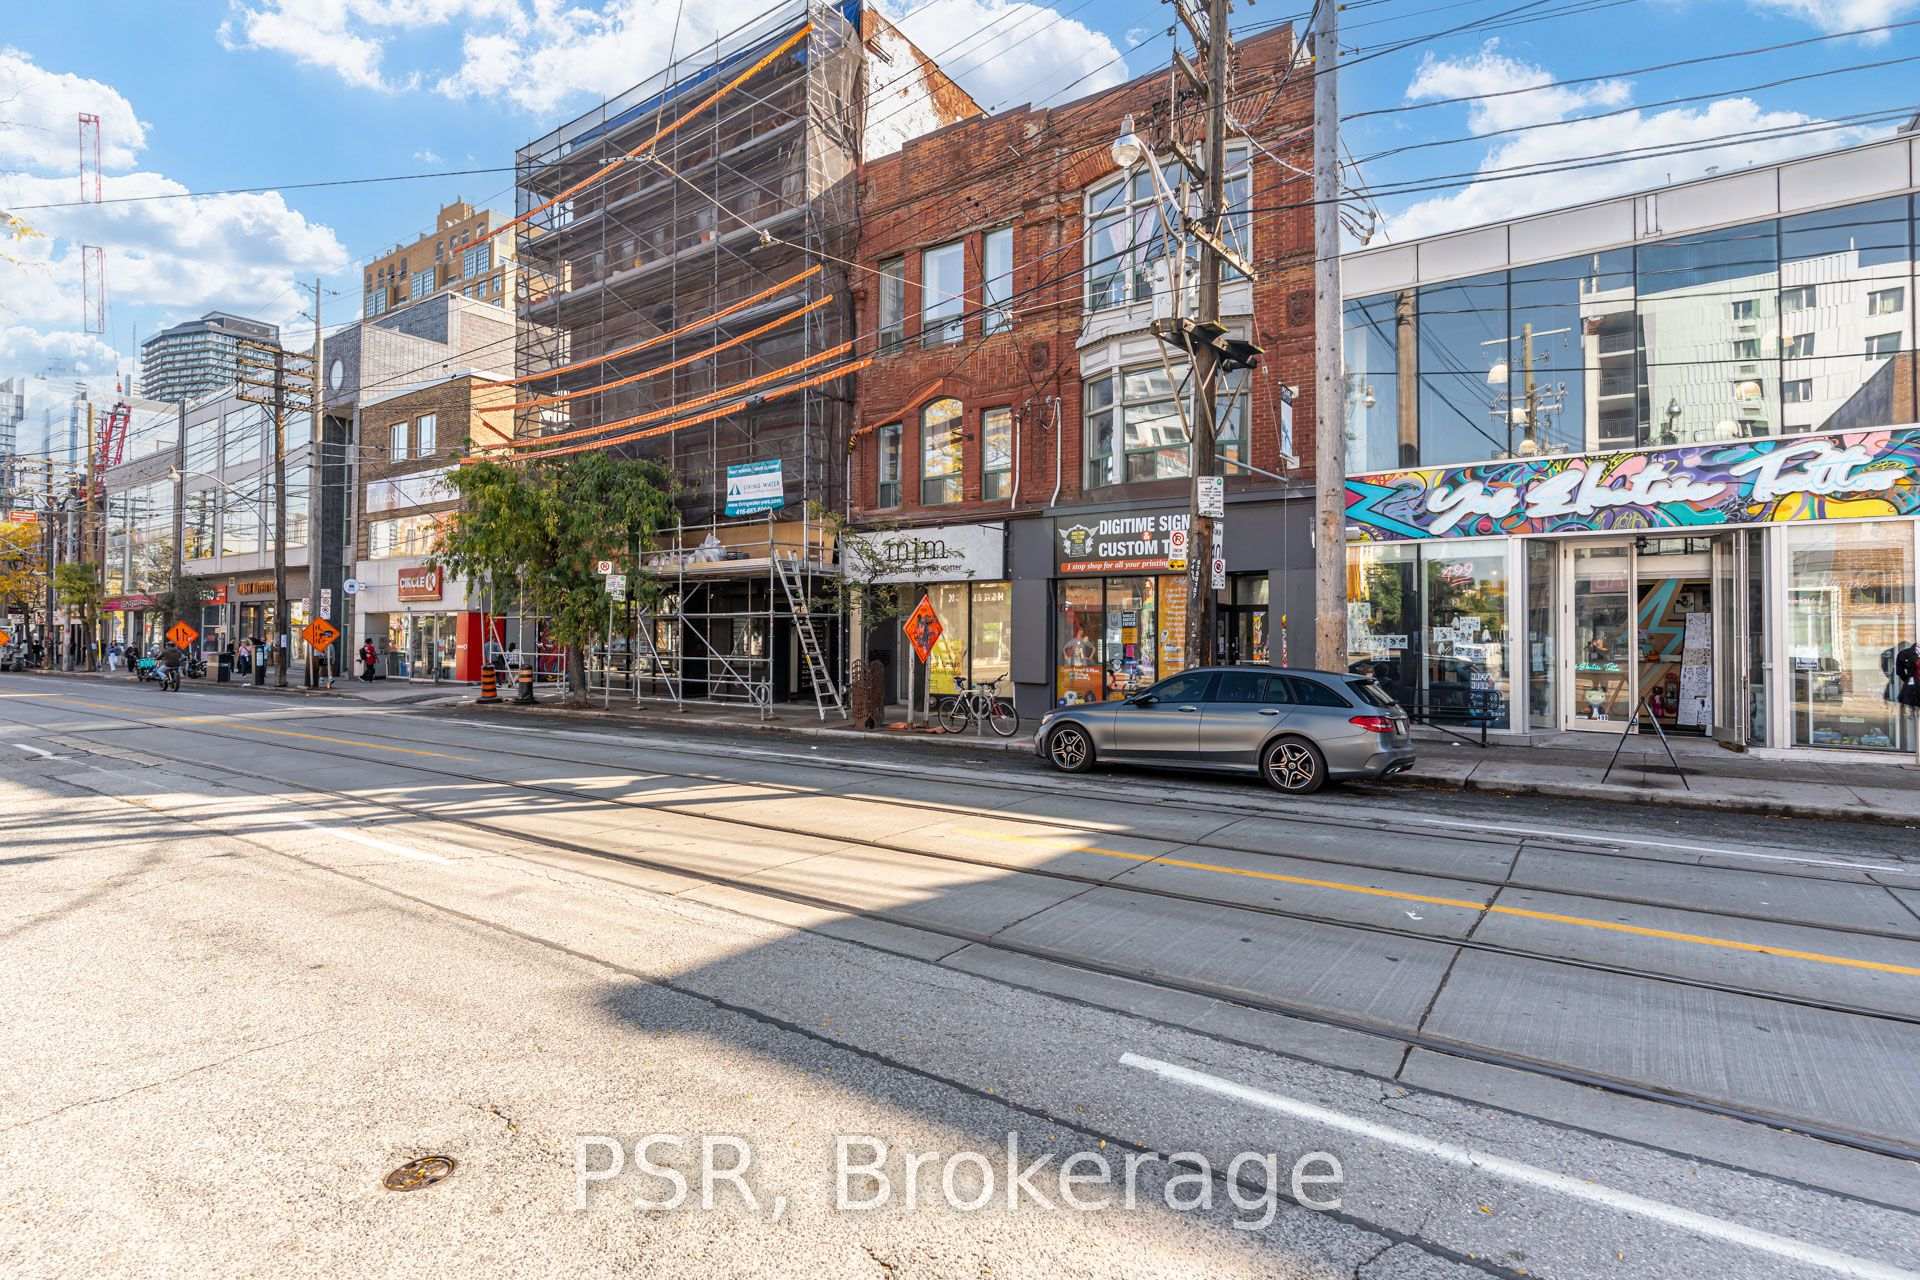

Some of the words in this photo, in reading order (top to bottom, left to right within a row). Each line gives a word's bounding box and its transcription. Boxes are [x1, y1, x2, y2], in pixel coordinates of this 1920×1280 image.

[1100, 516, 1155, 535] DIGITIME
[1099, 541, 1157, 557] CUSTOM
[1088, 562, 1103, 571] shop
[1103, 561, 1113, 569] for
[1114, 560, 1123, 568] all
[1124, 560, 1140, 569] your
[1142, 558, 1168, 568] printing
[400, 577, 425, 589] CIRCLE
[425, 572, 436, 592] K
